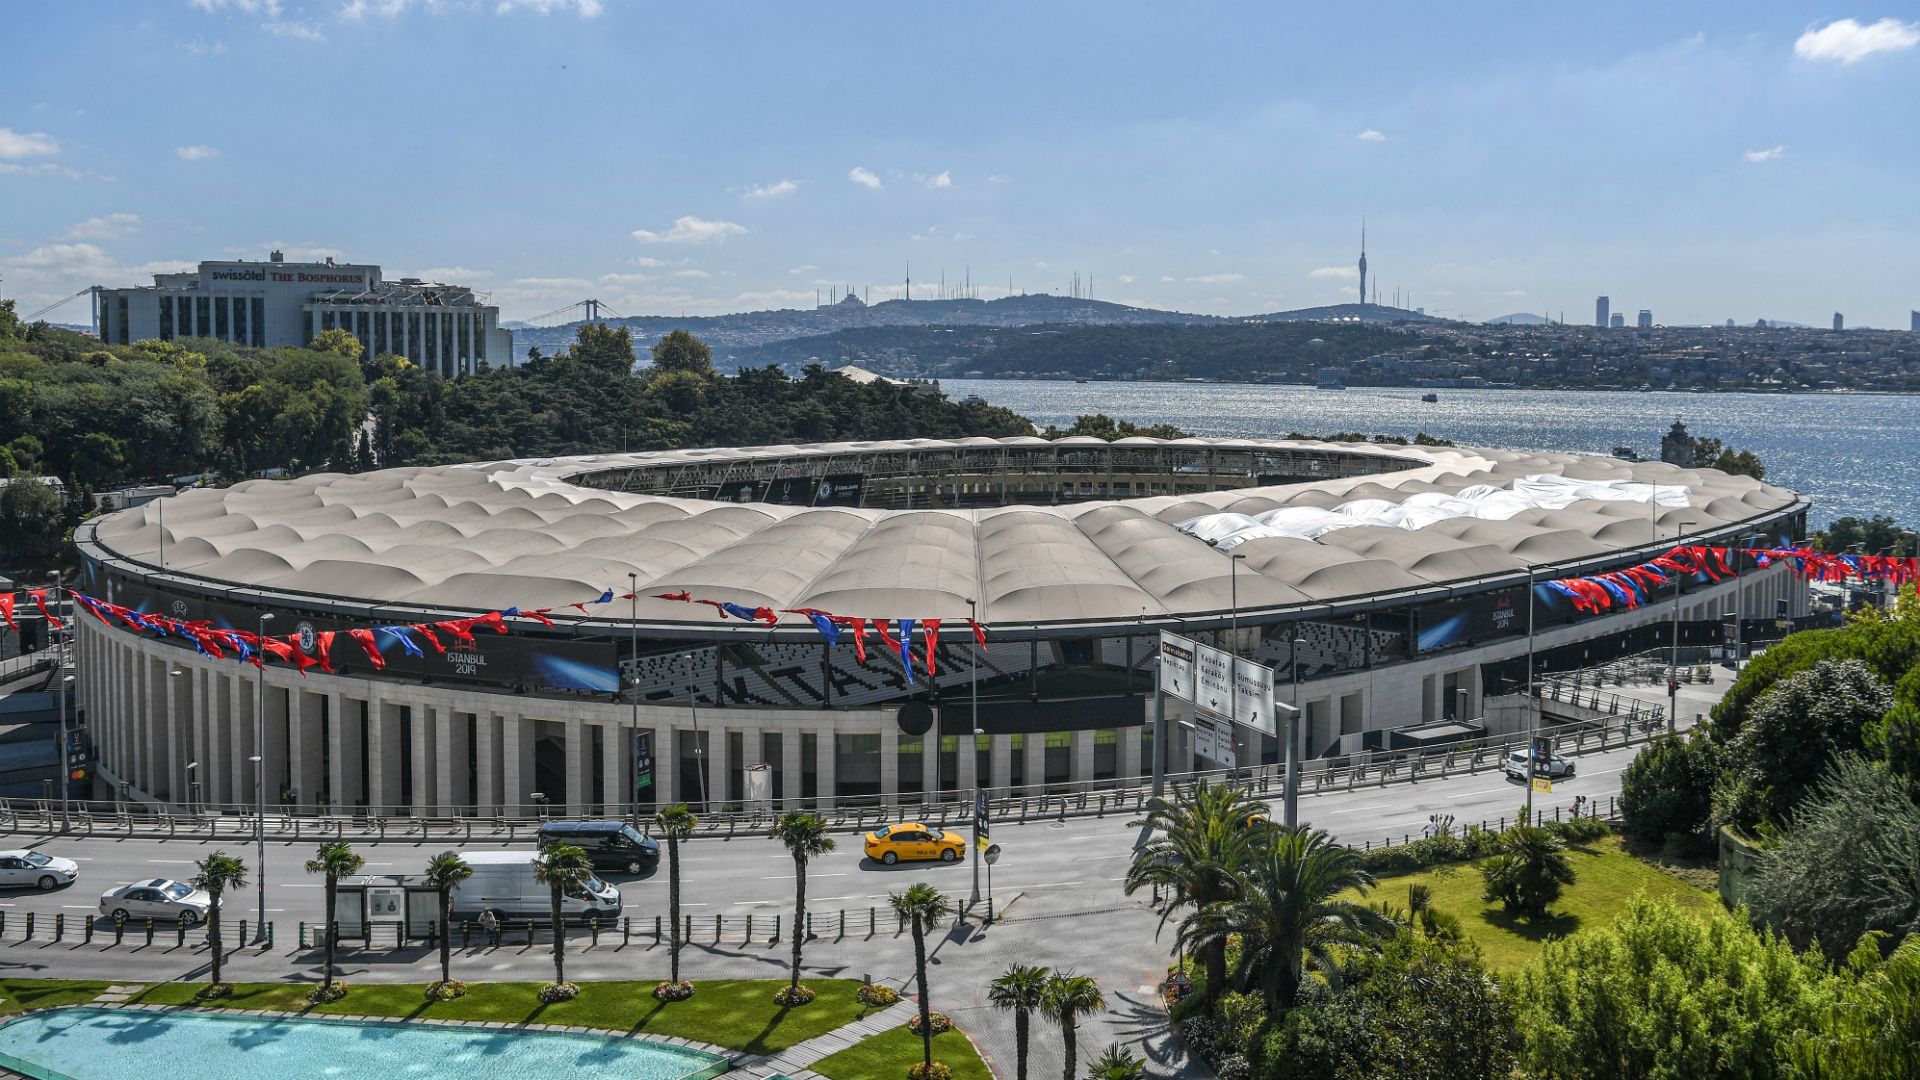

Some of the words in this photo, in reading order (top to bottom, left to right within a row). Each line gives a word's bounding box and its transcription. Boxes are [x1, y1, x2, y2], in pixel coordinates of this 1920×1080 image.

[212, 268, 266, 281] swissôtel
[270, 271, 294, 282] THE
[297, 272, 363, 284] BOSPHORUS
[447, 652, 488, 666] ISTANBUL
[455, 663, 477, 675] 2019
